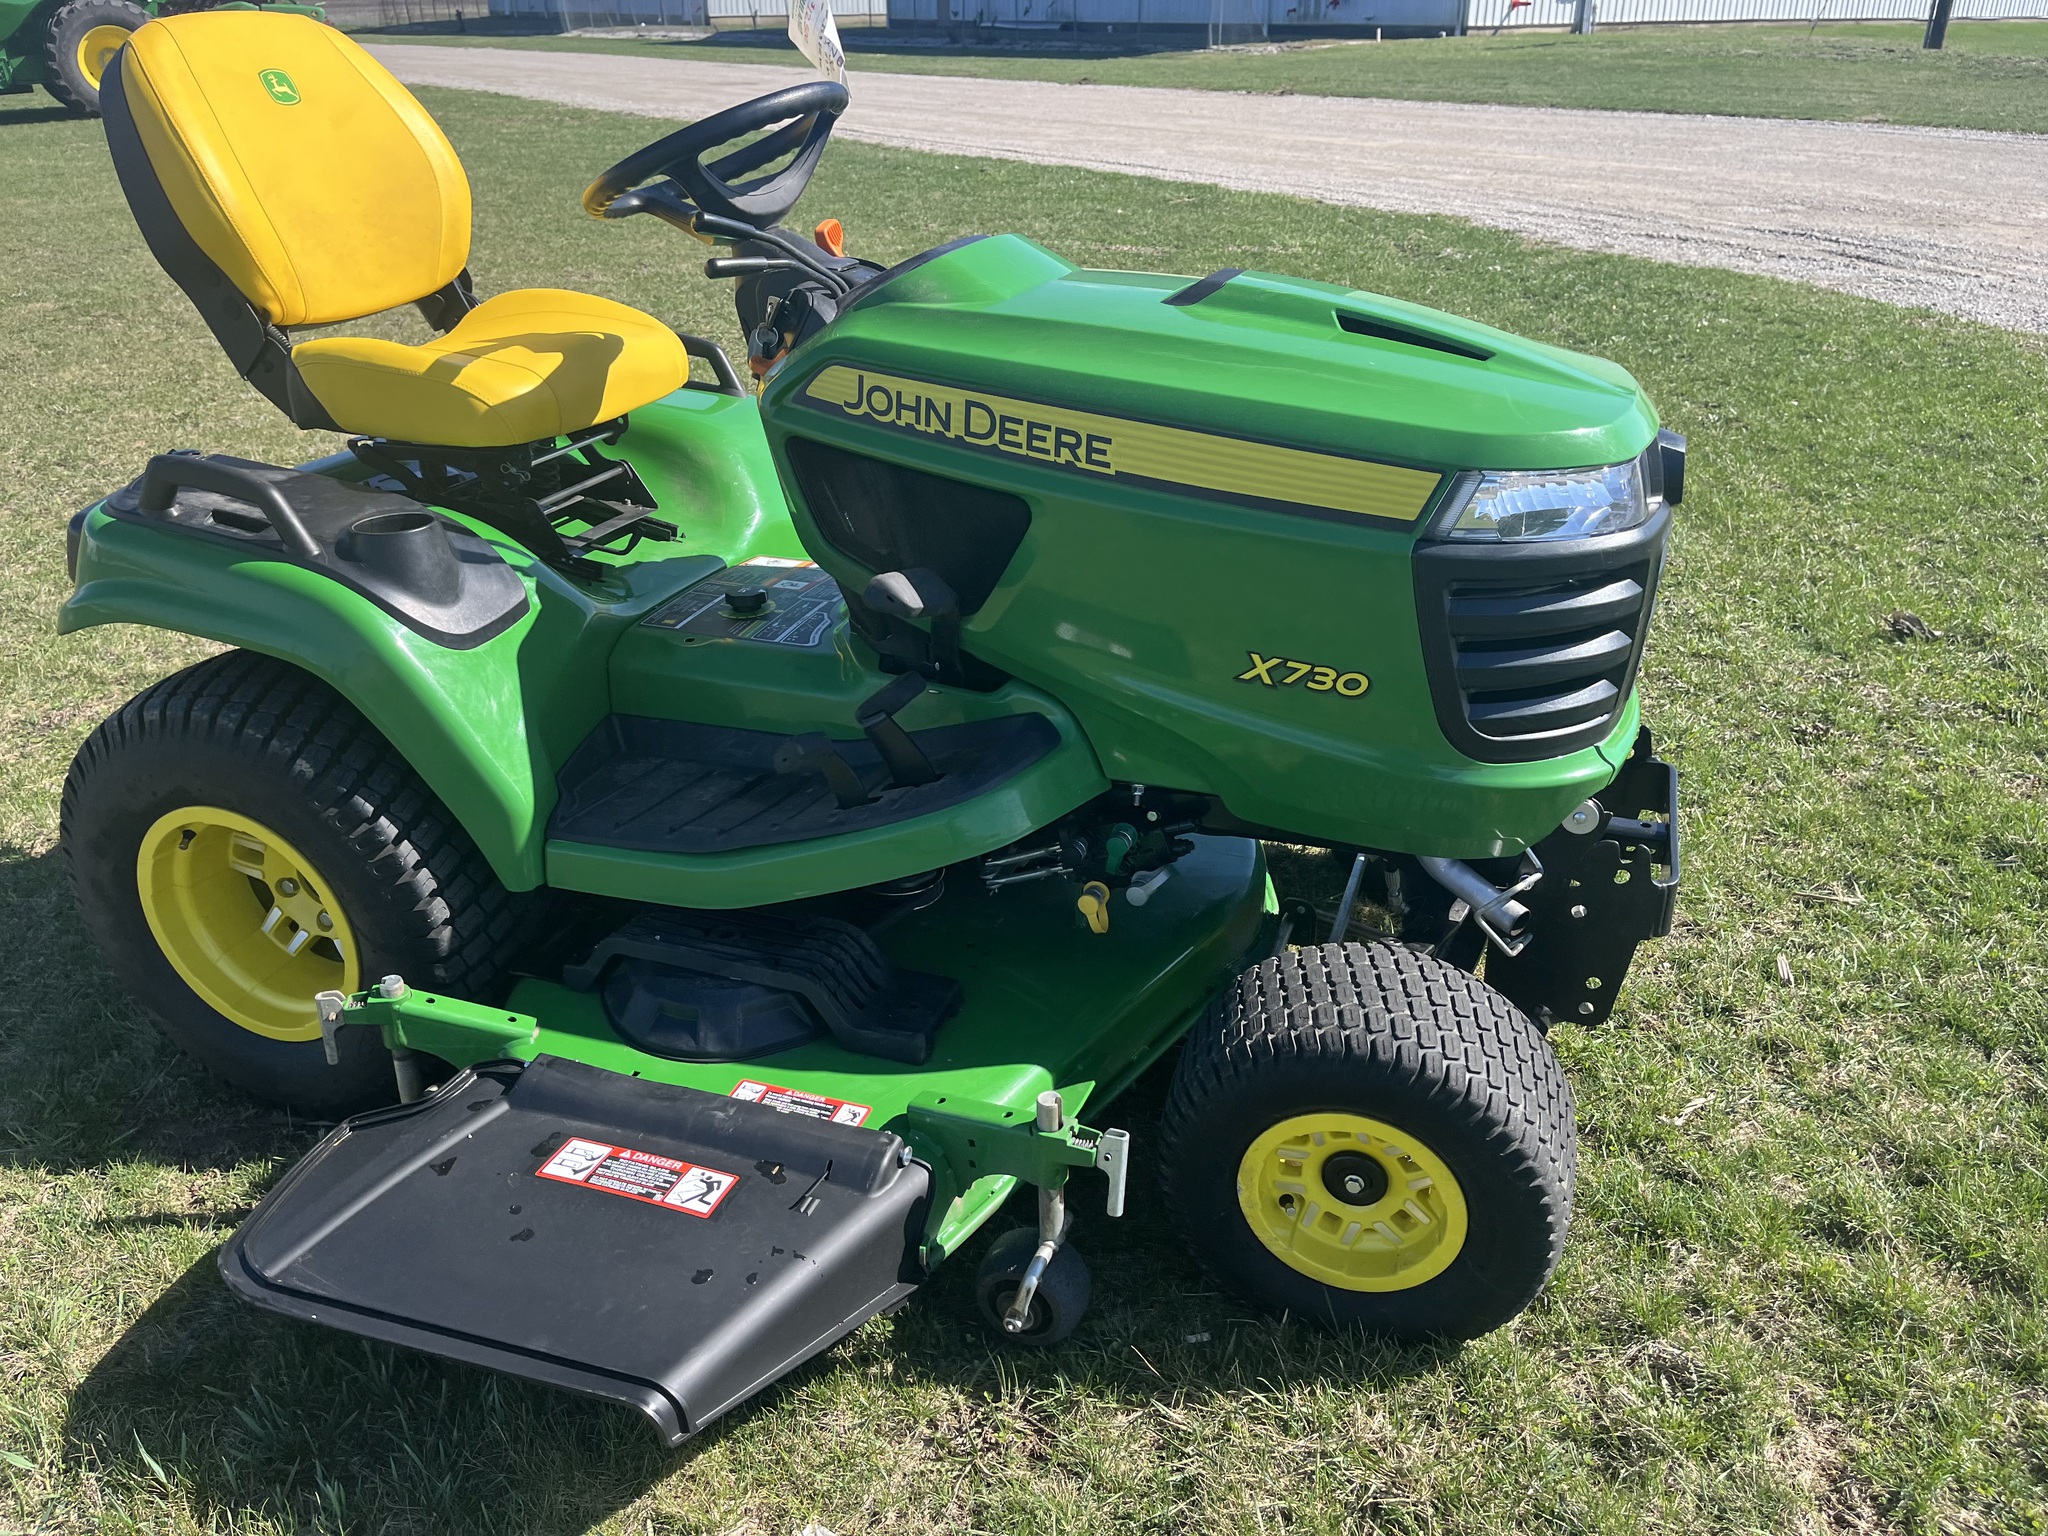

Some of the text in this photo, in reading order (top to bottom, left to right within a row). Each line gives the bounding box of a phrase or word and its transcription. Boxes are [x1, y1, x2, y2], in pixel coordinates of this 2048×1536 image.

[843, 374, 1113, 470] JOHN DEERE
[1237, 651, 1370, 697] X730
[793, 1091, 826, 1102] DANGER
[632, 1150, 683, 1170] DANGER
